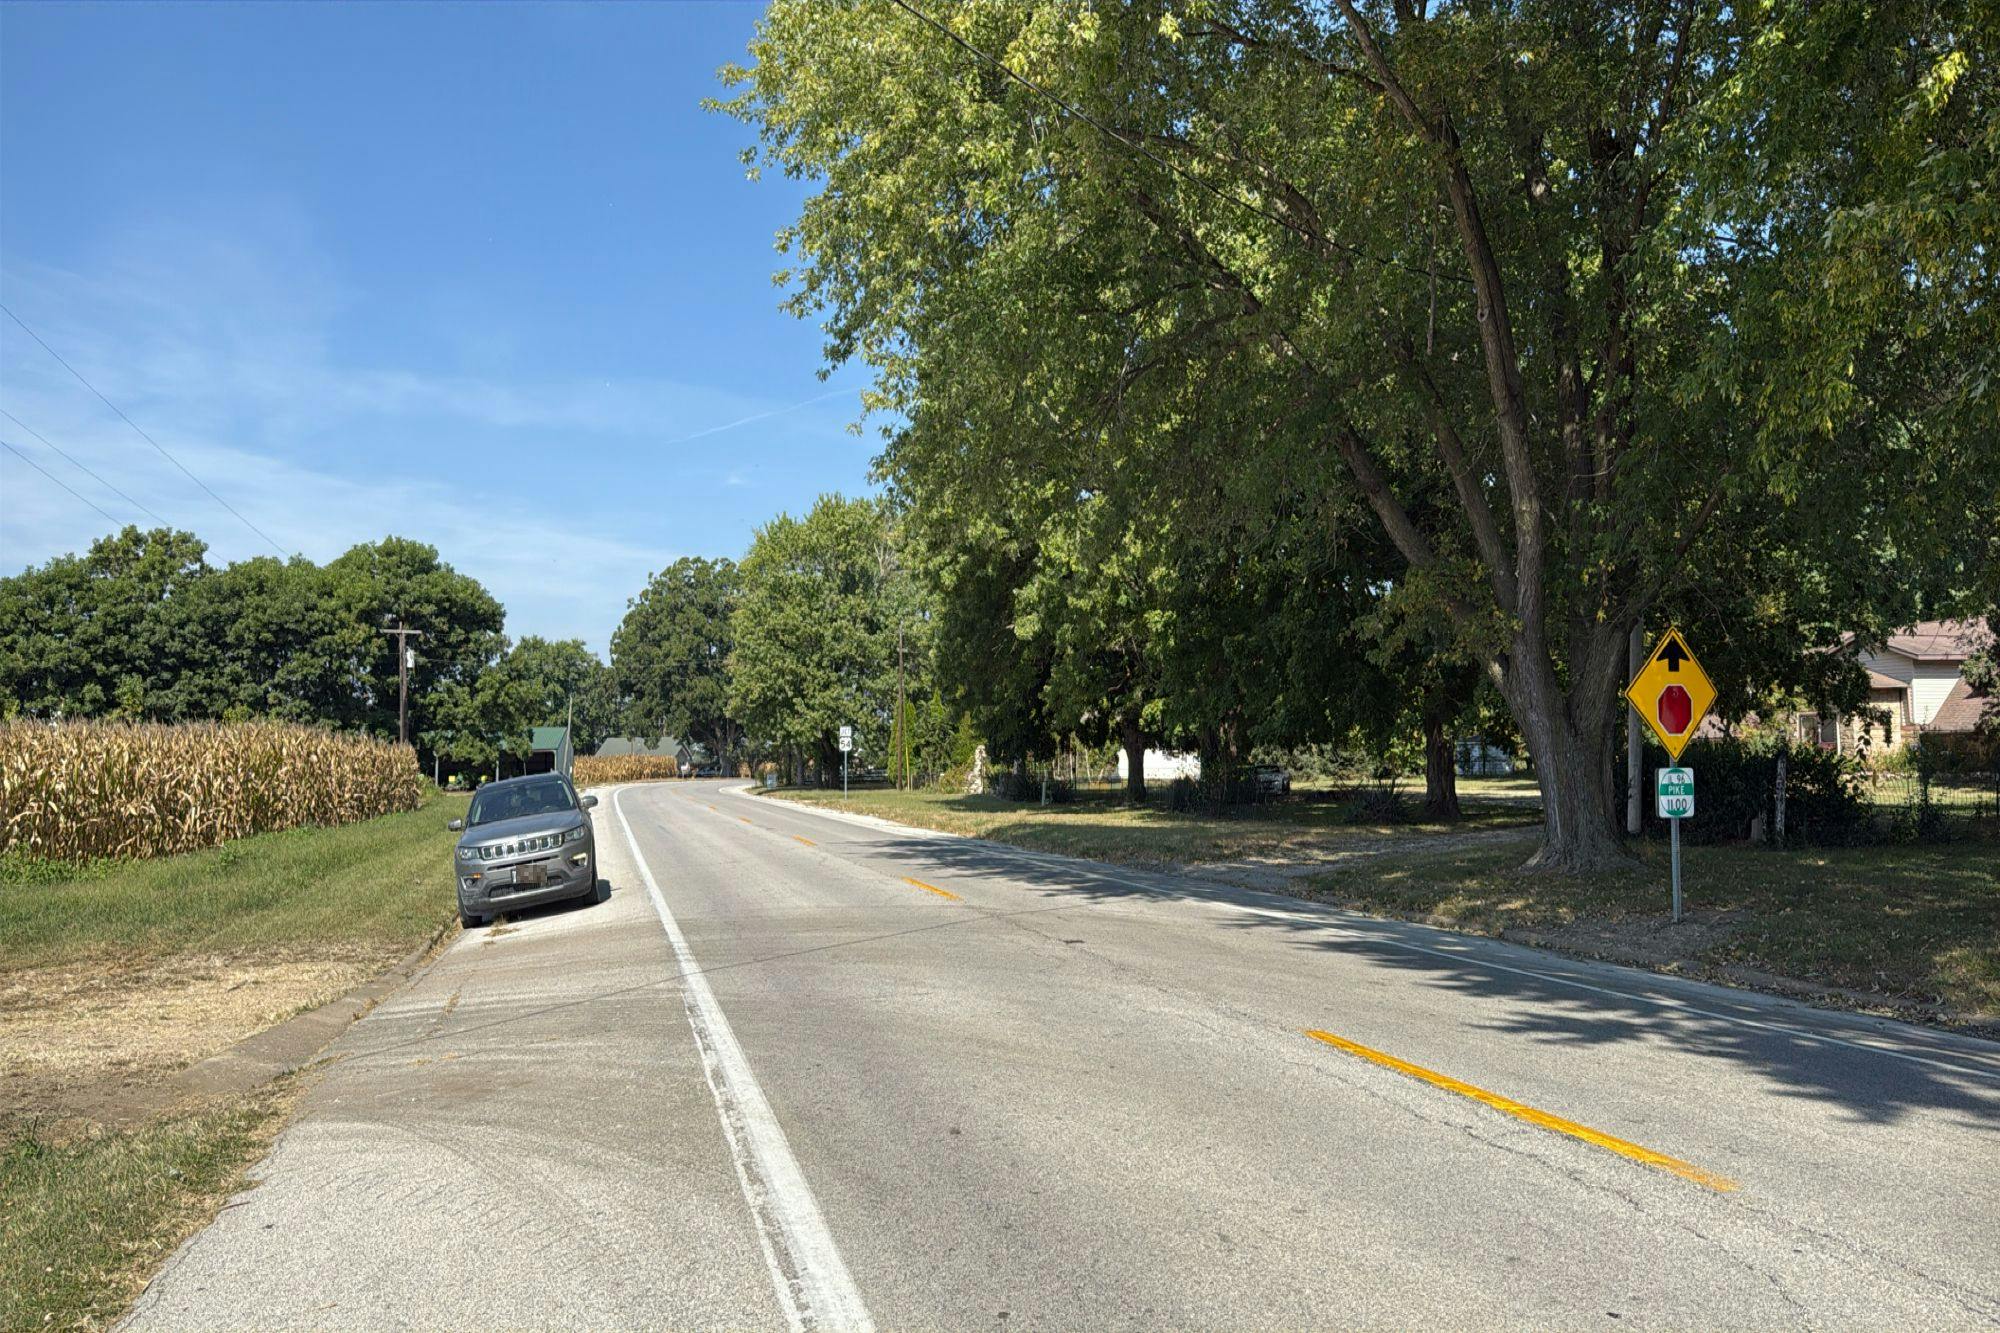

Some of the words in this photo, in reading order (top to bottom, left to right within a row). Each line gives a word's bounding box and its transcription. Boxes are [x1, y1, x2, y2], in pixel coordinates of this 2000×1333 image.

[841, 740, 850, 748] 54
[1677, 774, 1685, 784] 96
[1668, 785, 1685, 795] PIKE
